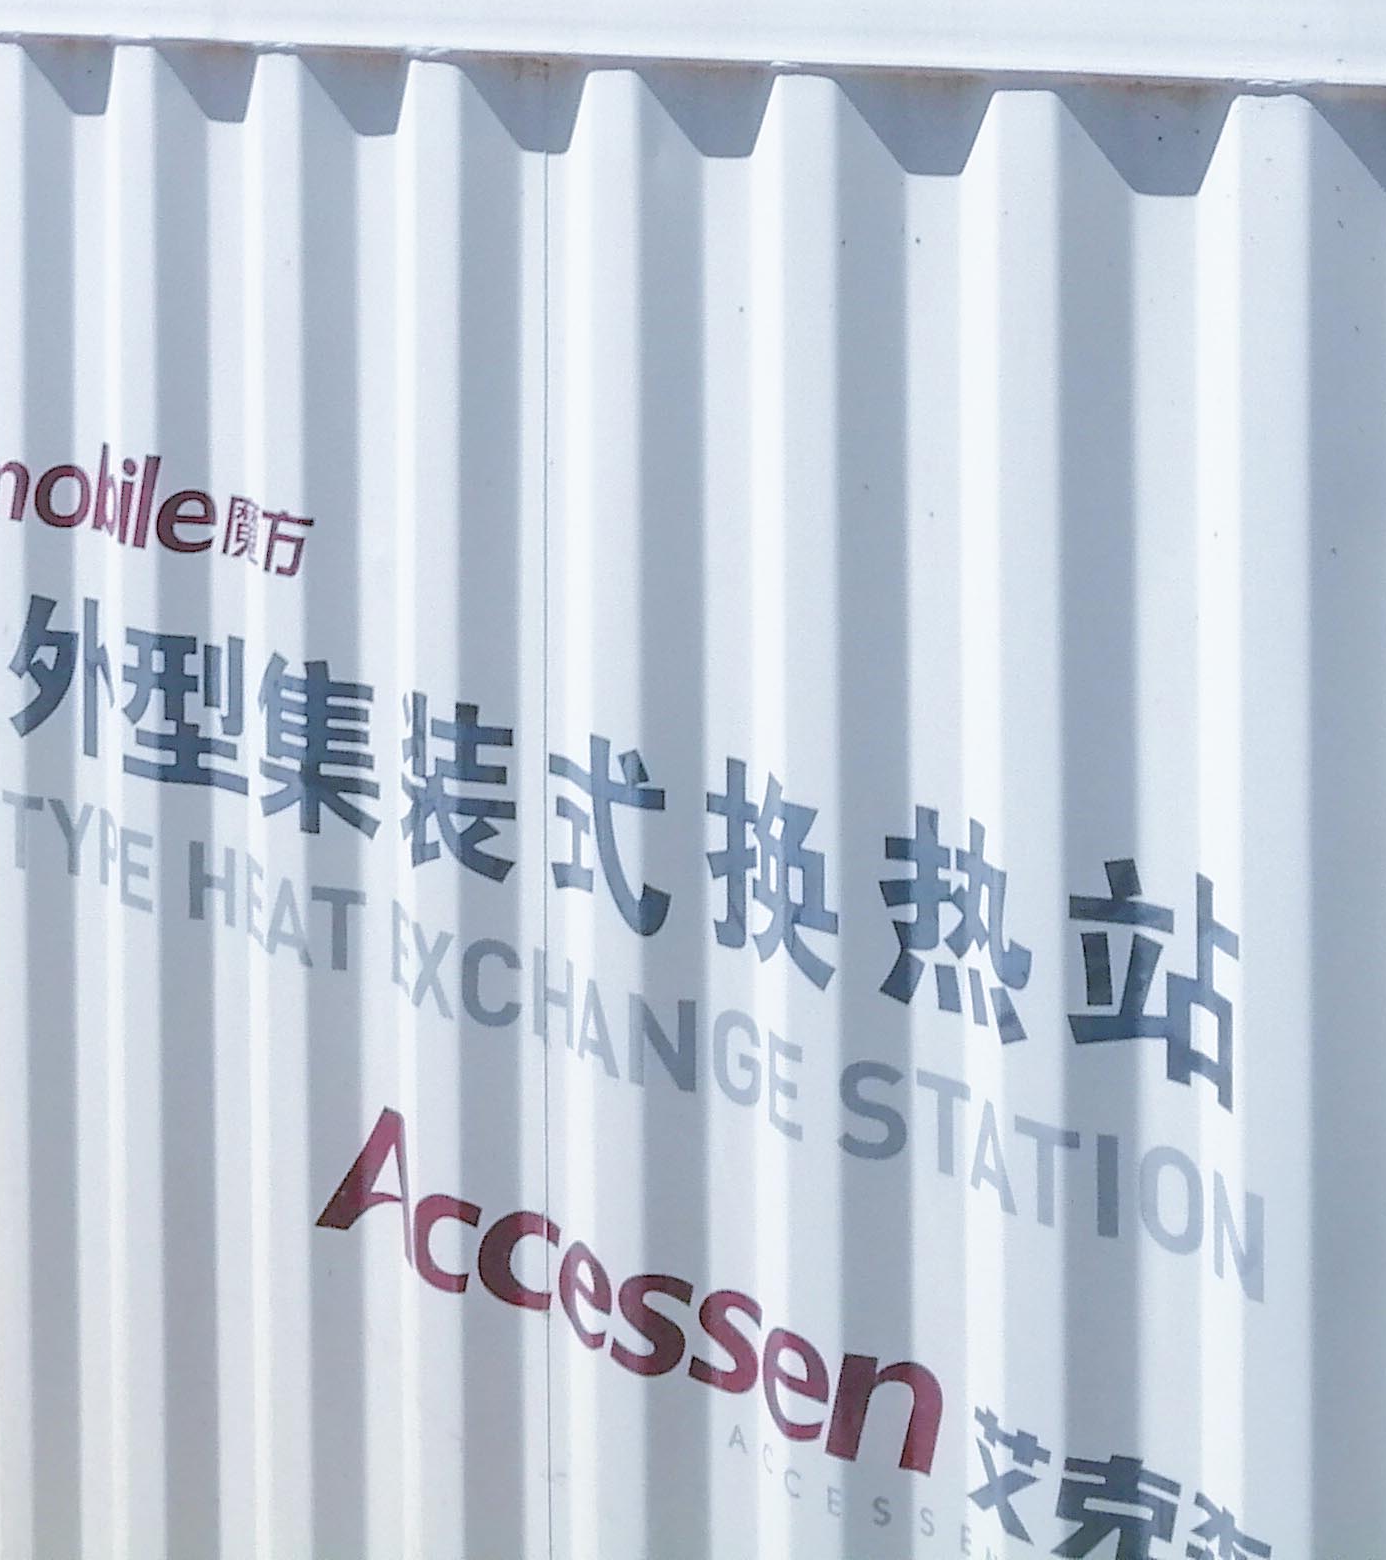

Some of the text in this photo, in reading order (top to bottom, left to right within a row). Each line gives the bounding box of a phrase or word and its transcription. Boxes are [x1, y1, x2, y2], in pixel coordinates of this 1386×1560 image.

[2, 789, 153, 914] TYPE
[188, 841, 366, 971] HEAT
[390, 899, 804, 1141] EXCHANGE
[837, 1060, 1265, 1304] STATION
[315, 1106, 944, 1476] Accessen
[728, 1424, 999, 1560] ACCESSE
